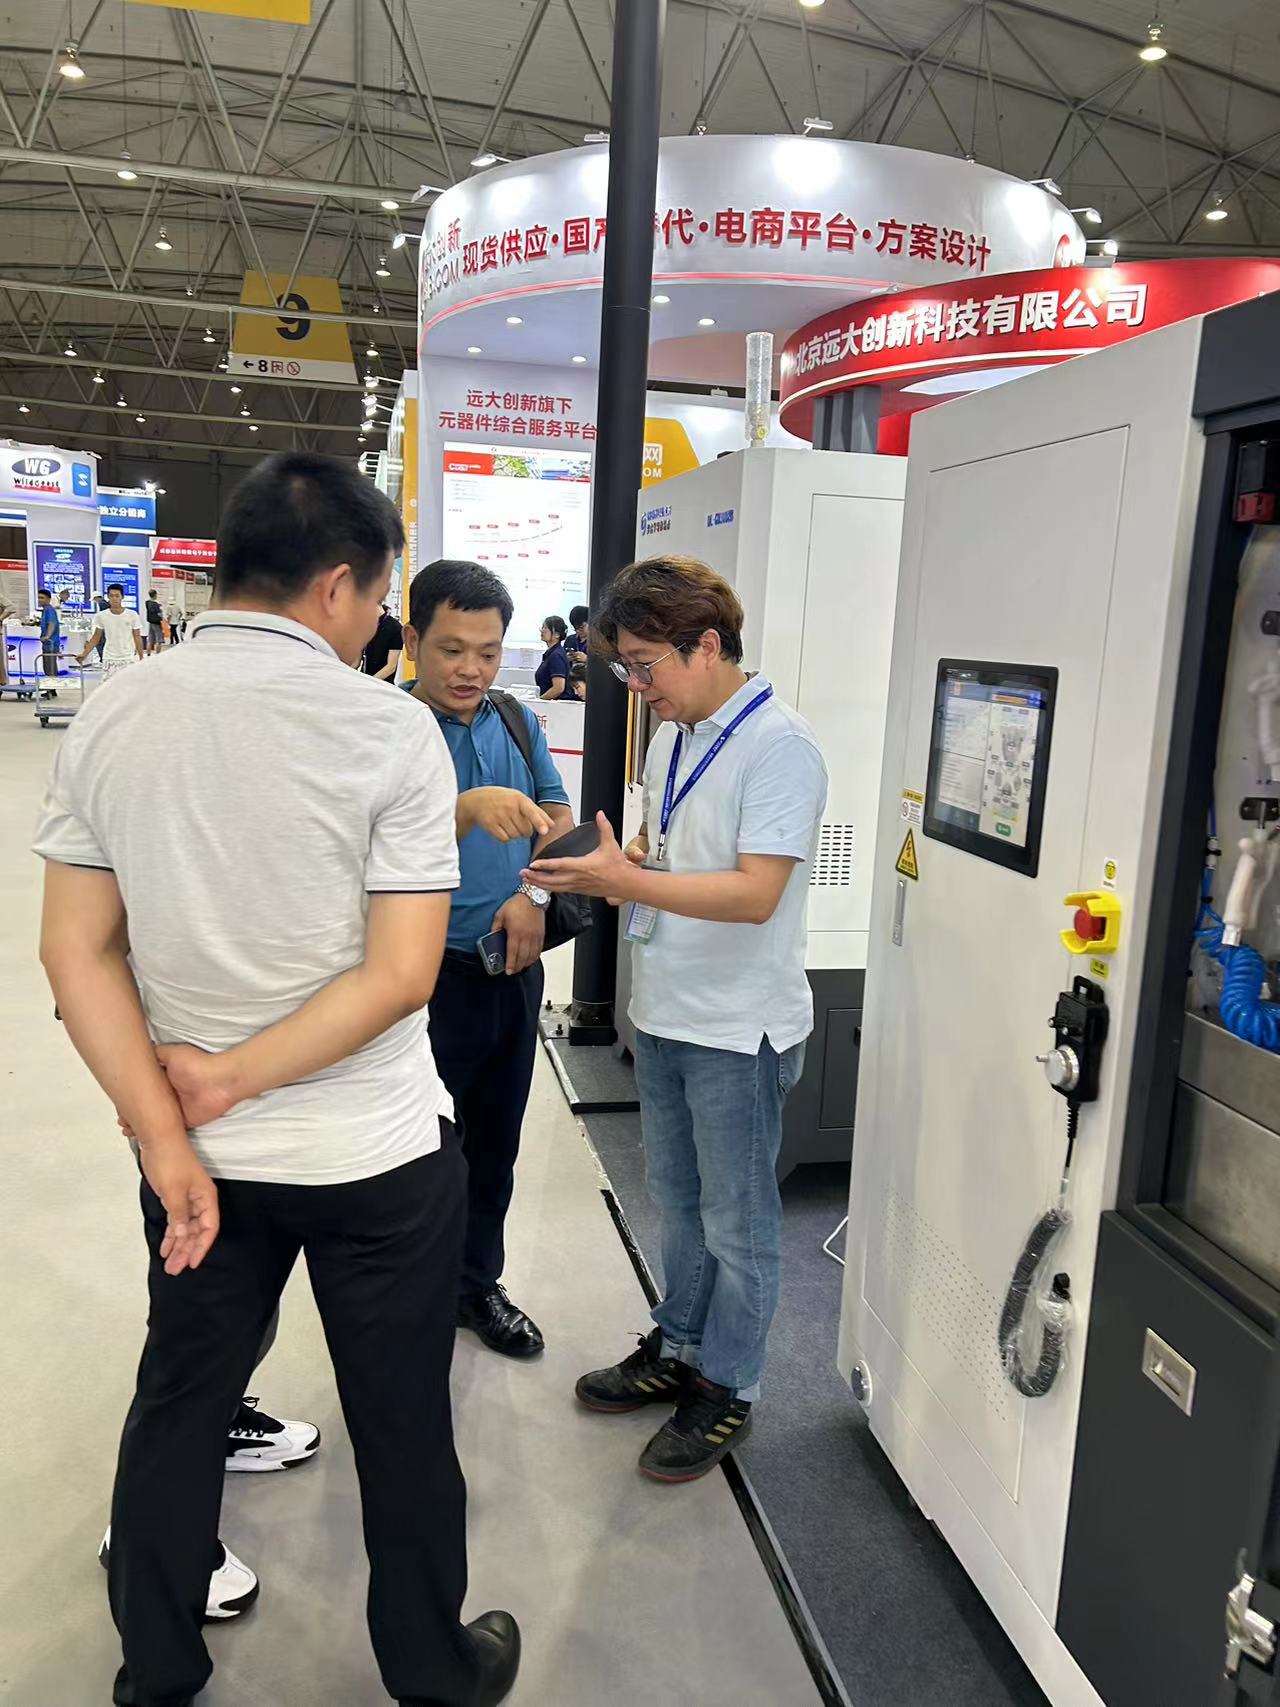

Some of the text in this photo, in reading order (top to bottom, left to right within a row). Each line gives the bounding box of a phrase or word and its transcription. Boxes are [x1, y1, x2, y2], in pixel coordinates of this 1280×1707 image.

[462, 207, 992, 276] 现货供应·国代·电商平台·方案设计
[276, 292, 311, 341] 9
[795, 284, 1148, 376] 北京远大创新科技有限公司
[258, 359, 269, 373] 8
[466, 389, 573, 415] 远大创新旗下
[438, 411, 598, 441] 元器件综合服务平台
[642, 467, 662, 478] OM
